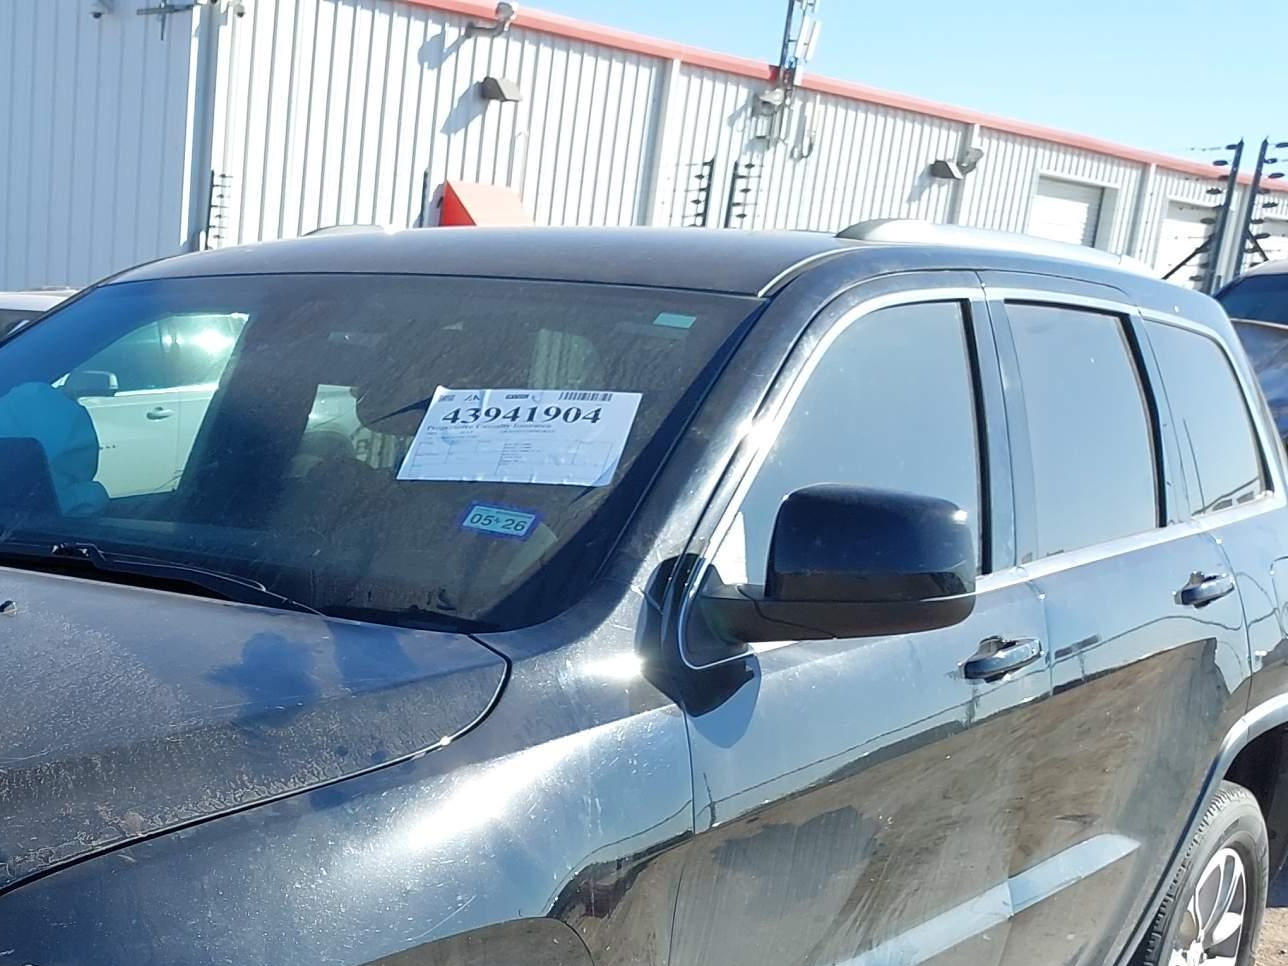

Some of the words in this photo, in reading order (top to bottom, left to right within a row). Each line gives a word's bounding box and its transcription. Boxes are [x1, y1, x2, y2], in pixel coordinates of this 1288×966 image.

[441, 405, 602, 425] 43941904
[470, 513, 492, 526] 05
[502, 518, 527, 532] 26
